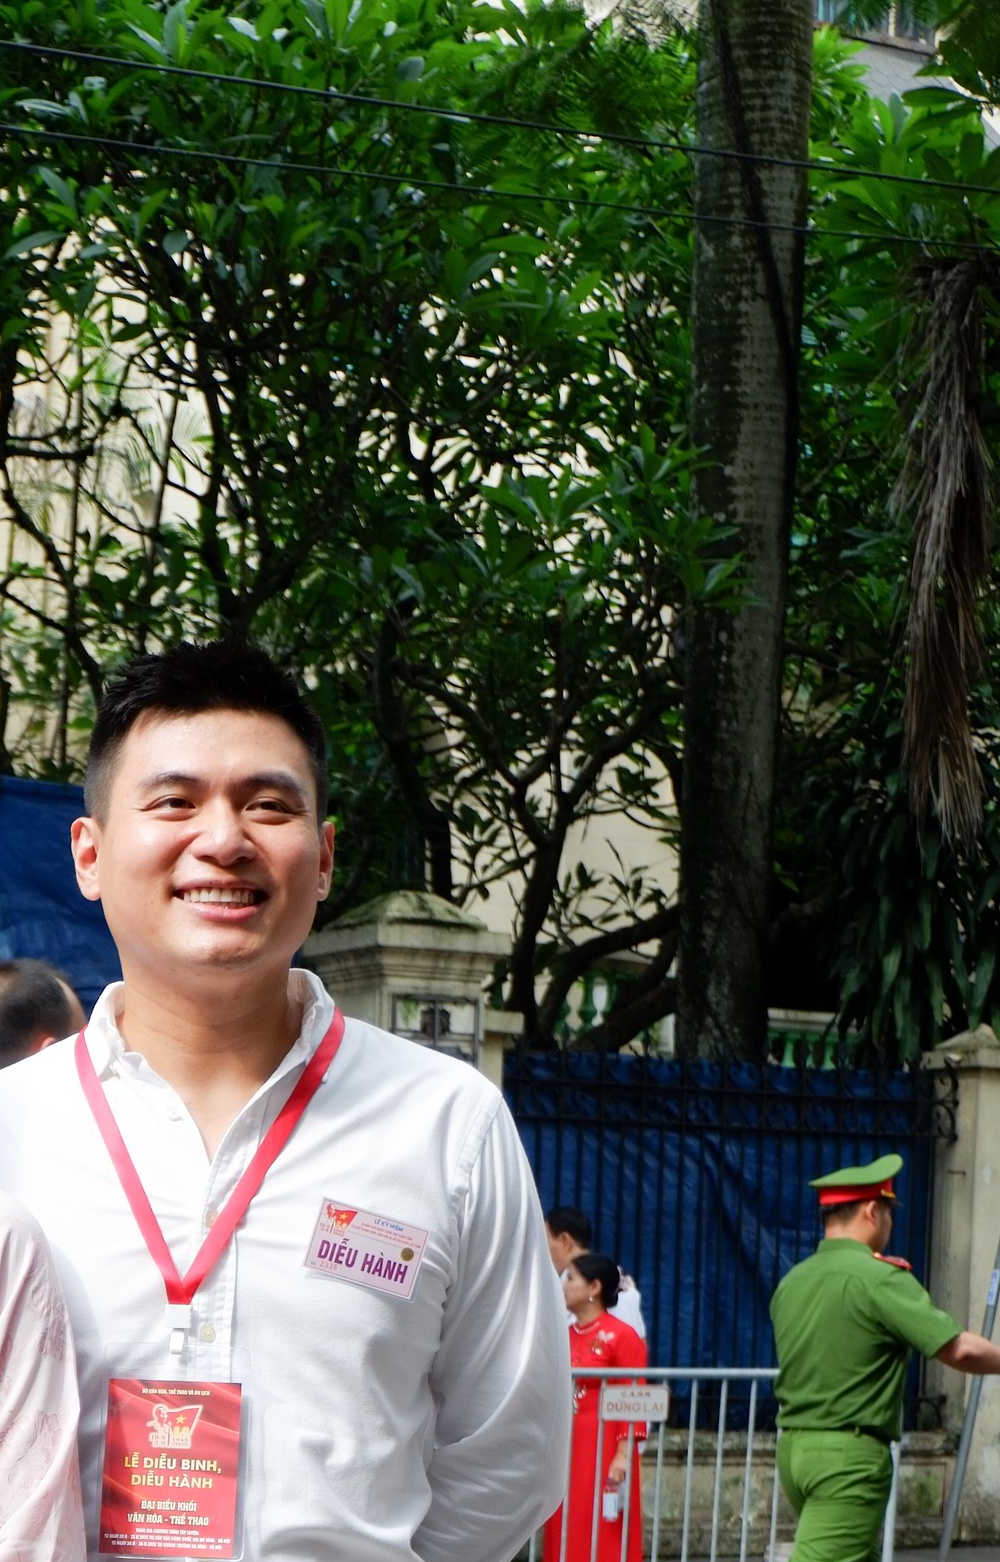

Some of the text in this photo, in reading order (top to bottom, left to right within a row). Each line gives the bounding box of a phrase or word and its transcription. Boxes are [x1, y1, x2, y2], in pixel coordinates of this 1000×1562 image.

[317, 1238, 408, 1284] DIỄU HÀNH
[124, 1452, 221, 1474] LỄ DIỄU BINH,
[131, 1470, 212, 1489] DIỄU HÀNH
[127, 1513, 145, 1523] VĂN
[187, 1516, 209, 1526] THAO
